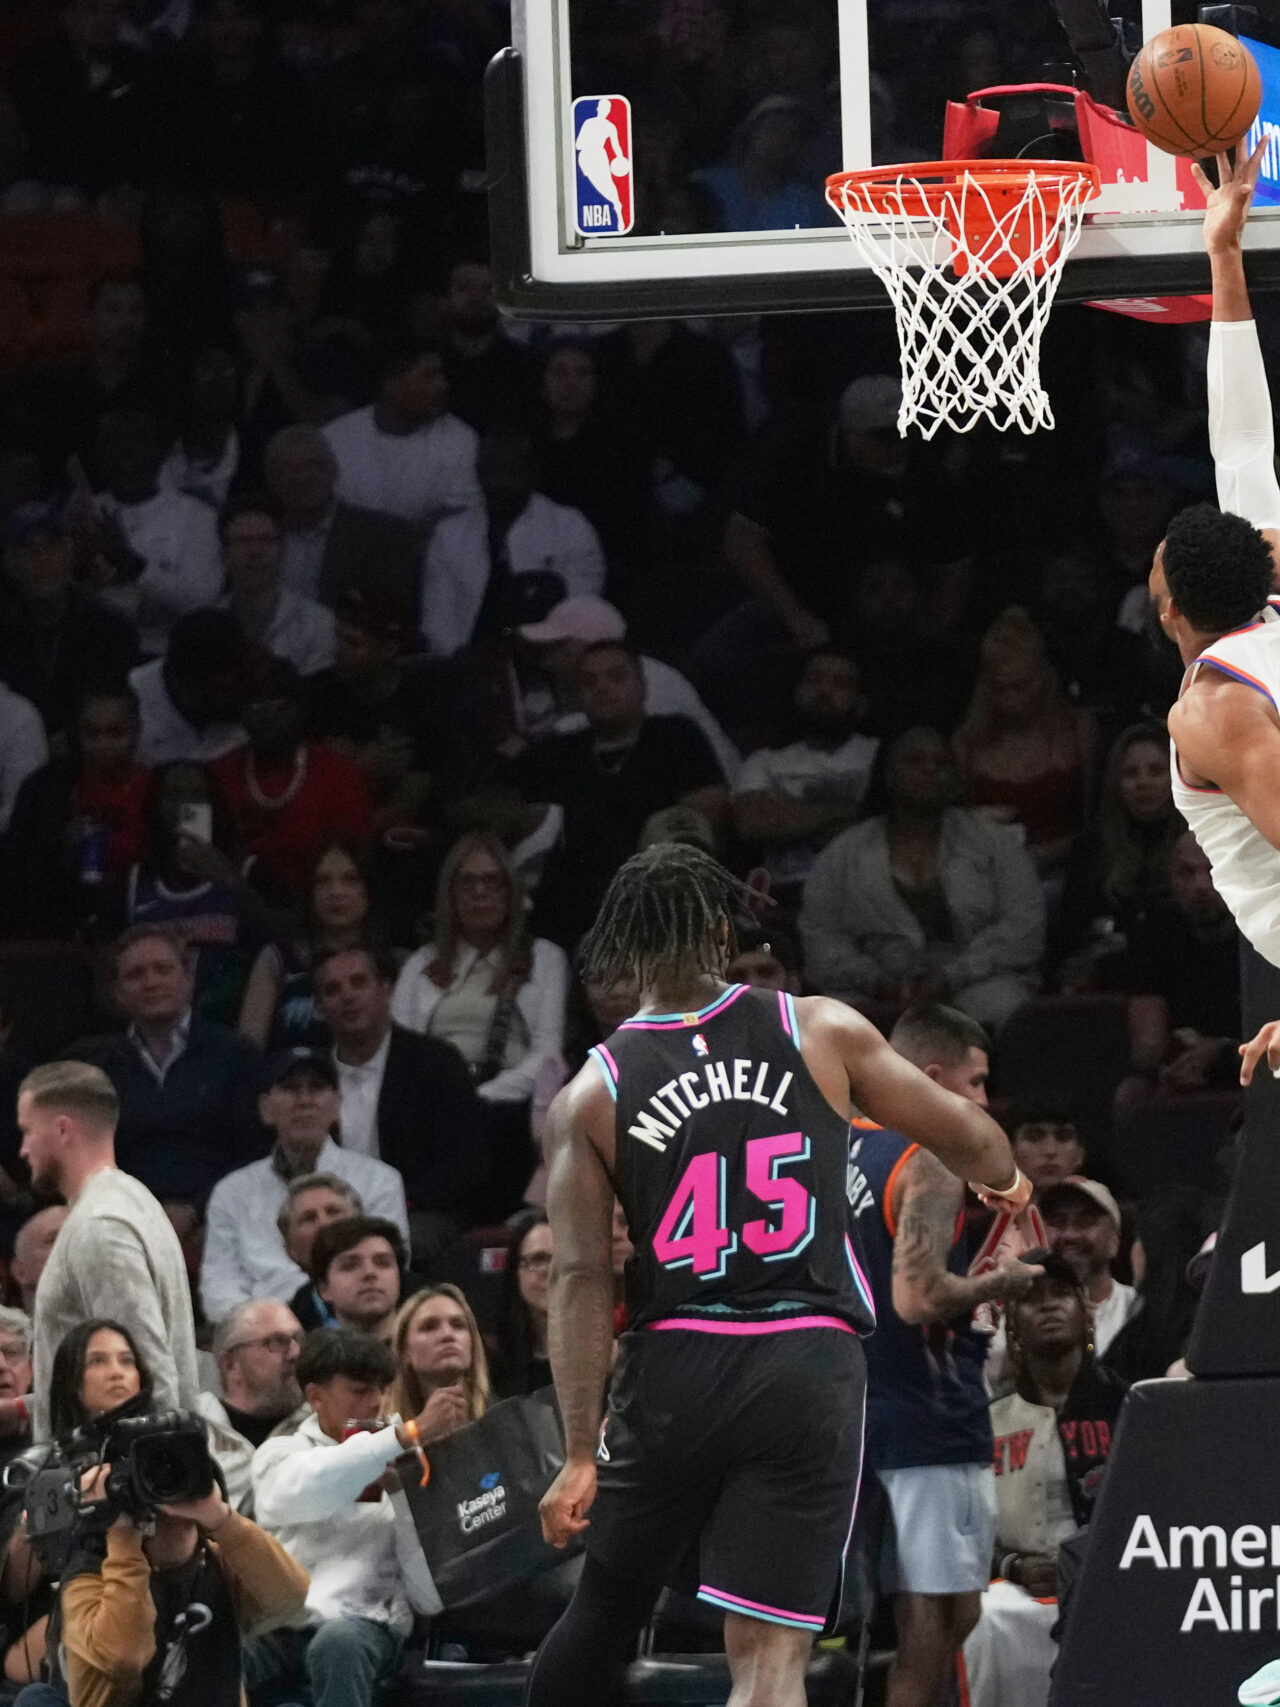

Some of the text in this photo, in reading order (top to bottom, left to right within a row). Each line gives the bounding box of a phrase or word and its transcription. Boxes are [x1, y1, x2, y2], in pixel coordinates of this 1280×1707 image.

[583, 204, 612, 227] NBA
[628, 1058, 793, 1152] MITCHELL
[653, 1132, 816, 1281] 45
[993, 1420, 1110, 1476] EW YOR
[457, 1485, 505, 1518] Kaseya
[461, 1501, 506, 1532] Center
